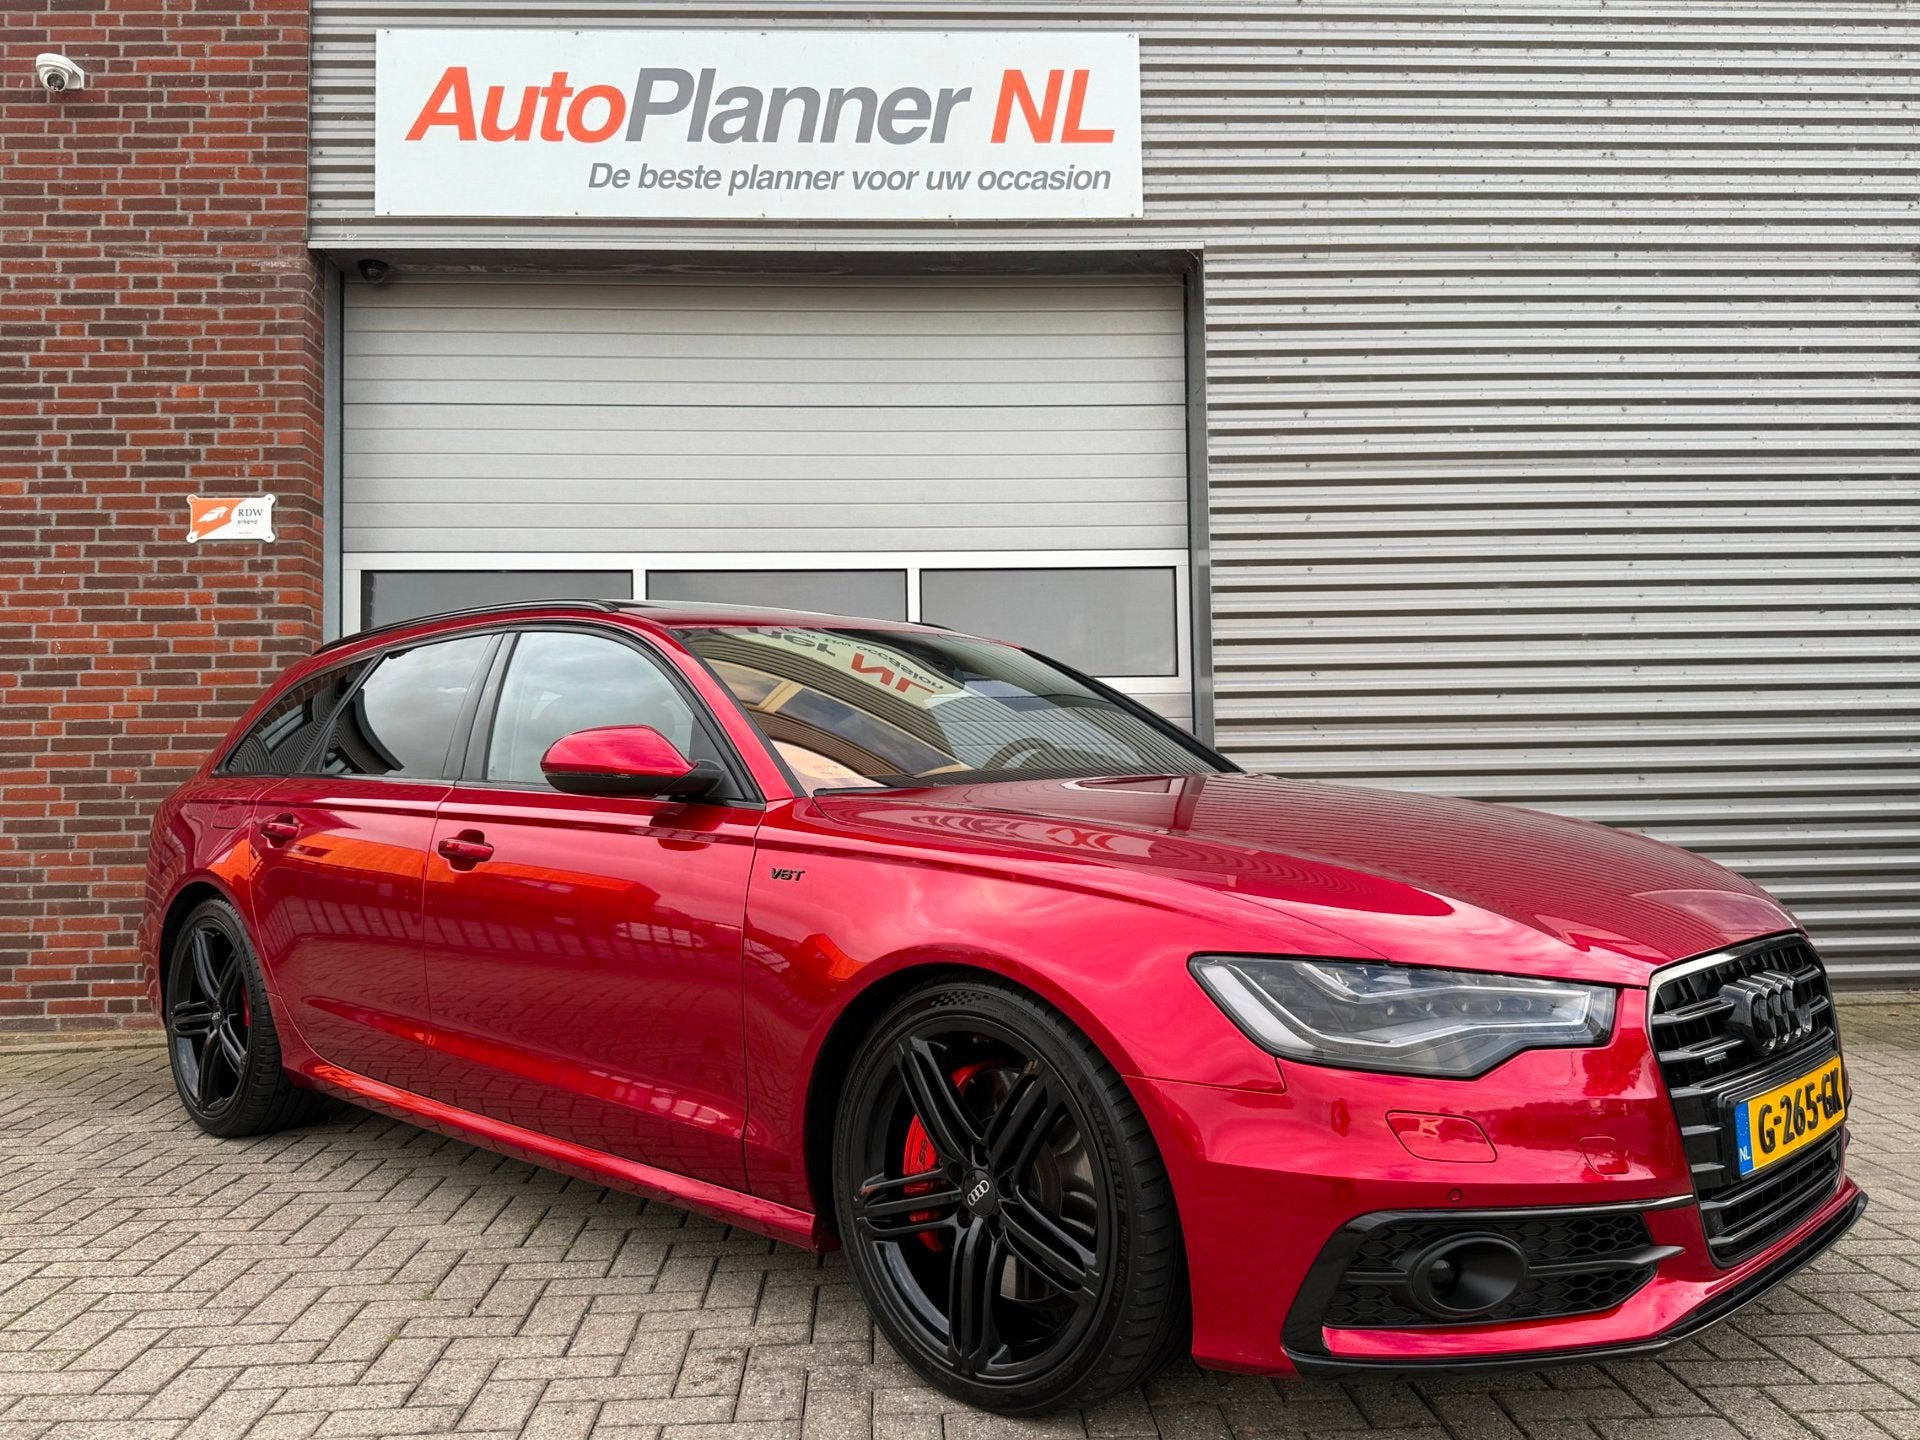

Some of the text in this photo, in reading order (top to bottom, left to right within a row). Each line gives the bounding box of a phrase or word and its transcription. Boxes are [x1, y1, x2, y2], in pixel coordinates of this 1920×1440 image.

[405, 67, 1115, 145] AutoPlanner NL
[588, 163, 1111, 197] De beste planner voor uw occasion
[237, 508, 264, 517] RDW
[771, 867, 806, 882] V6T
[1739, 1145, 1751, 1162] NL
